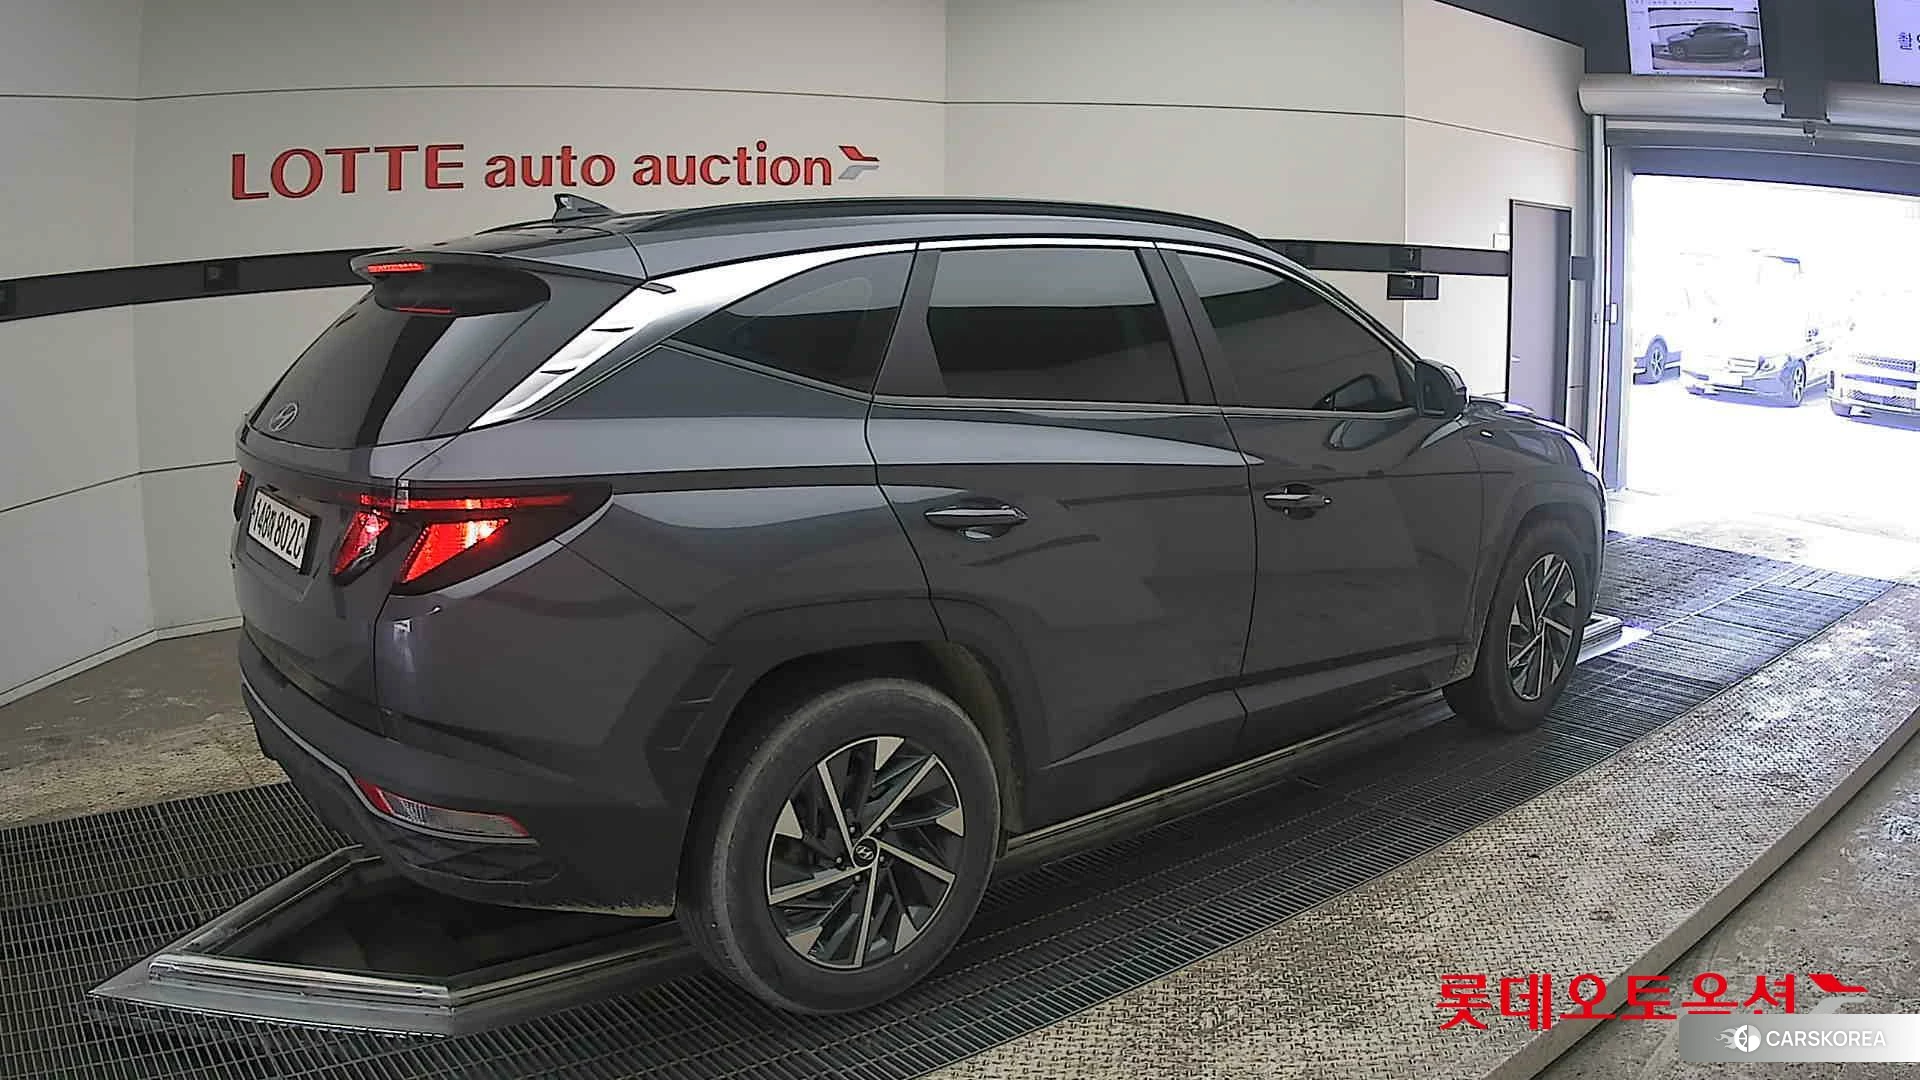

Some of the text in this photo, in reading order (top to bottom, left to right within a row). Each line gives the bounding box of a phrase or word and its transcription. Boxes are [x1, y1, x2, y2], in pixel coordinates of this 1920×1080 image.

[231, 141, 832, 200] LOTTE auto auction
